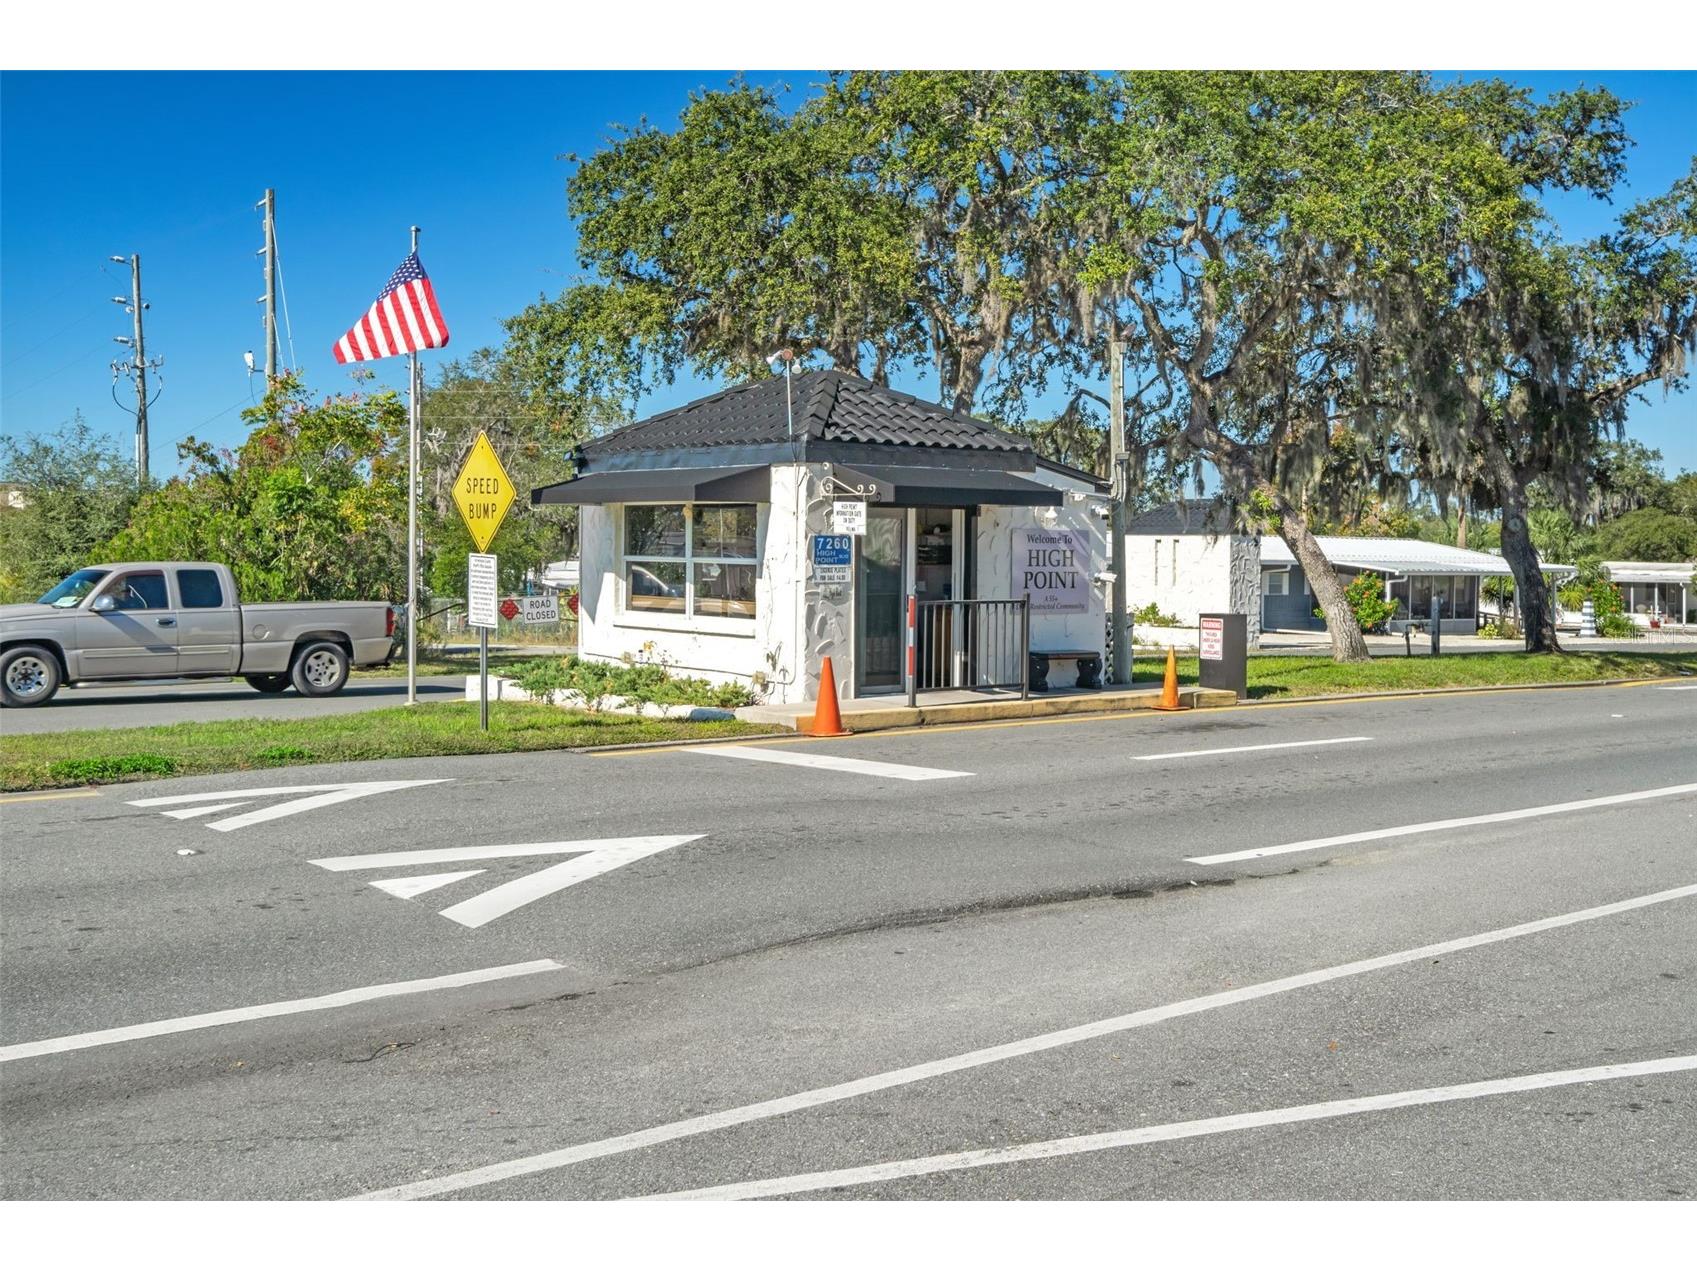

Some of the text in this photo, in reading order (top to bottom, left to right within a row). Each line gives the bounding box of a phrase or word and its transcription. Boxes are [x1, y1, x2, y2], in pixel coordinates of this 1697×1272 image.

[466, 477, 499, 494] SPEED
[469, 503, 497, 519] BUMP
[817, 537, 849, 550] 7260
[1026, 534, 1073, 544] Welcome To
[816, 549, 836, 557] HIGH
[1027, 549, 1075, 567] HIGH
[815, 556, 838, 564] POINT
[1024, 571, 1079, 589] POINT
[530, 600, 551, 609] ROAD
[1030, 602, 1055, 610] Restricted
[1055, 602, 1086, 611] Community
[526, 610, 557, 621] CLOSED
